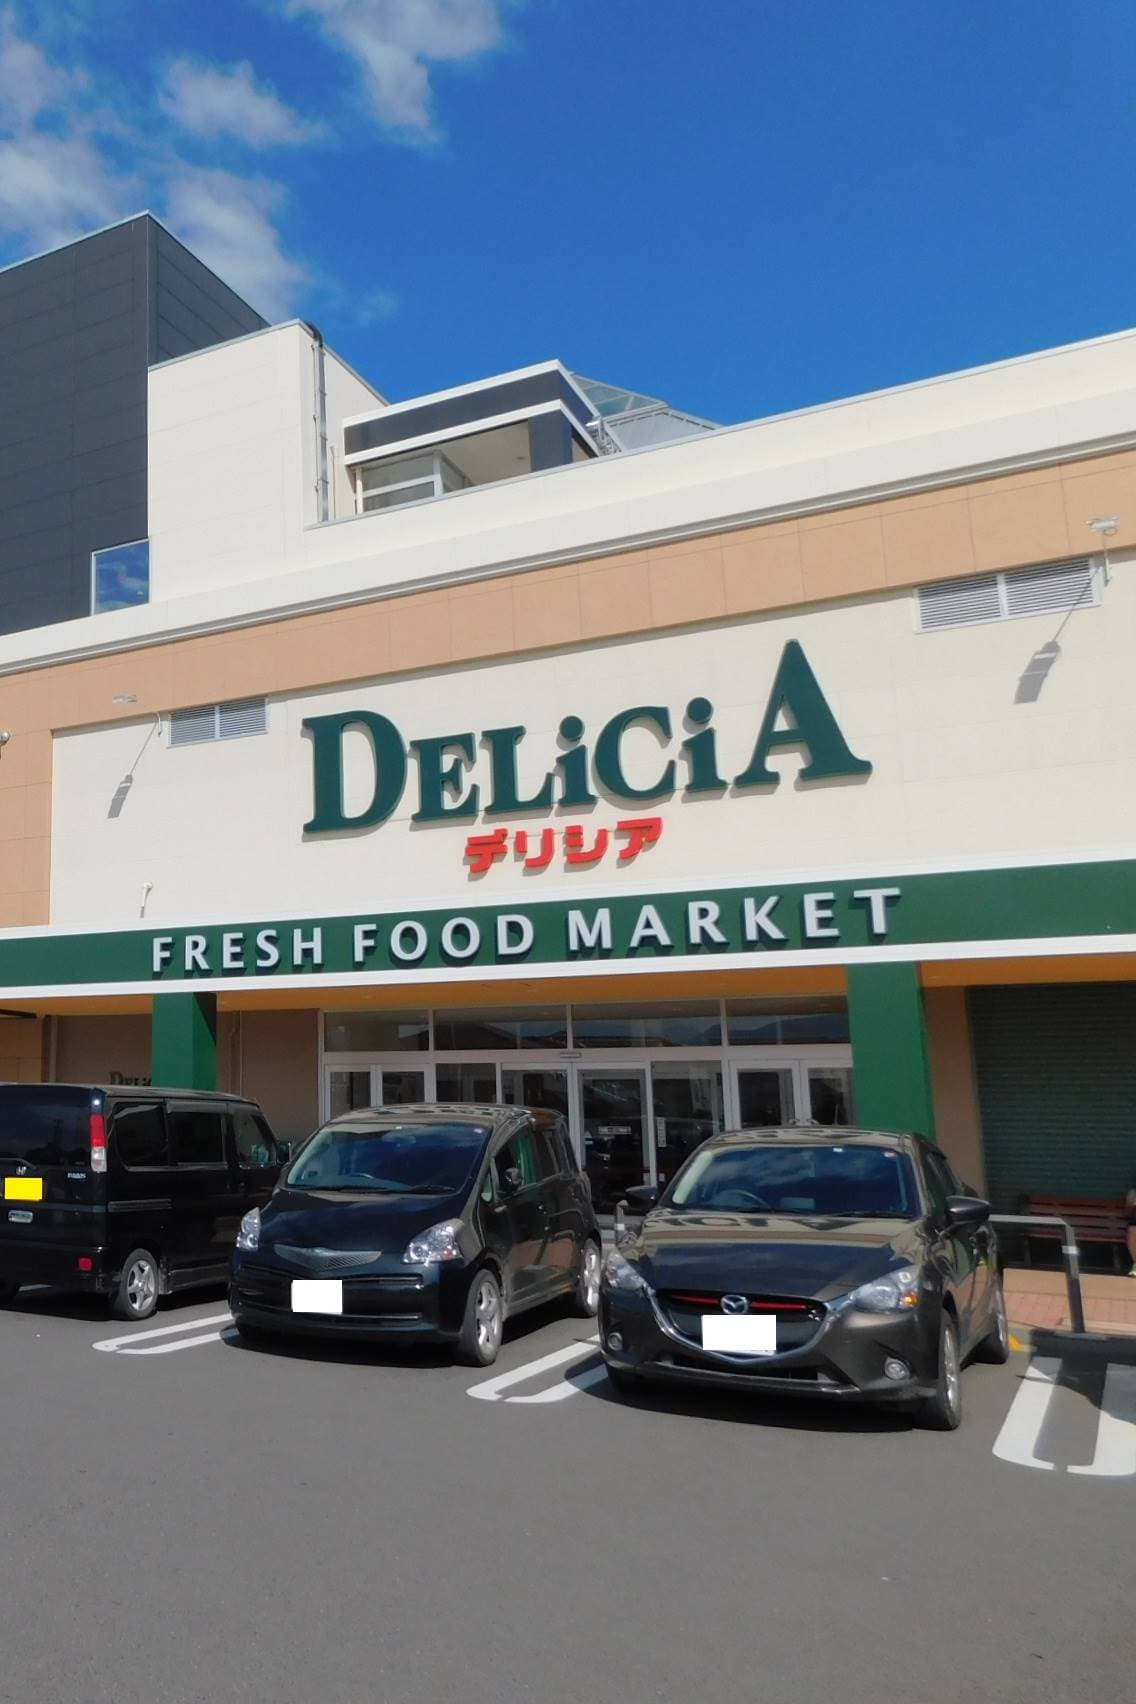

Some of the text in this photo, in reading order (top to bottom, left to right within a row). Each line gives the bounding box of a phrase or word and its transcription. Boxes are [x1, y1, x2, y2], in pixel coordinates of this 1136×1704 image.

[465, 816, 663, 874] デリシア
[152, 887, 901, 972] FRESH FOOD MARKET
